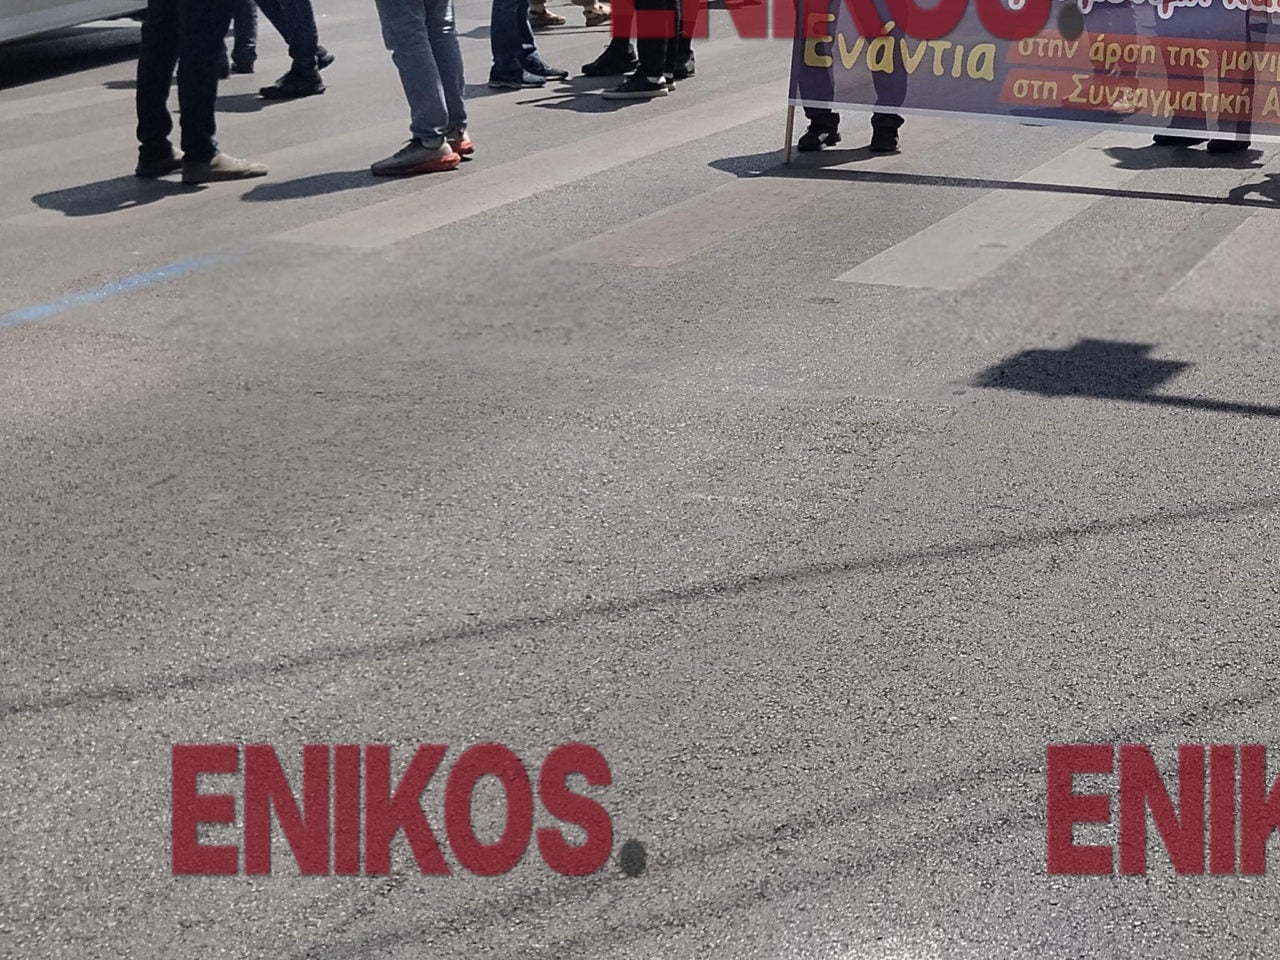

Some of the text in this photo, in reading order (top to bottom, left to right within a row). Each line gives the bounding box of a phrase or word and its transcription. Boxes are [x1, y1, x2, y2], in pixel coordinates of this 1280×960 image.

[803, 12, 996, 81] Ενάντια
[1017, 36, 1079, 59] στην
[1089, 34, 1157, 70] άρση
[1167, 45, 1210, 69] της
[1012, 80, 1058, 101] στη
[1068, 73, 1251, 119] Συνταγματική
